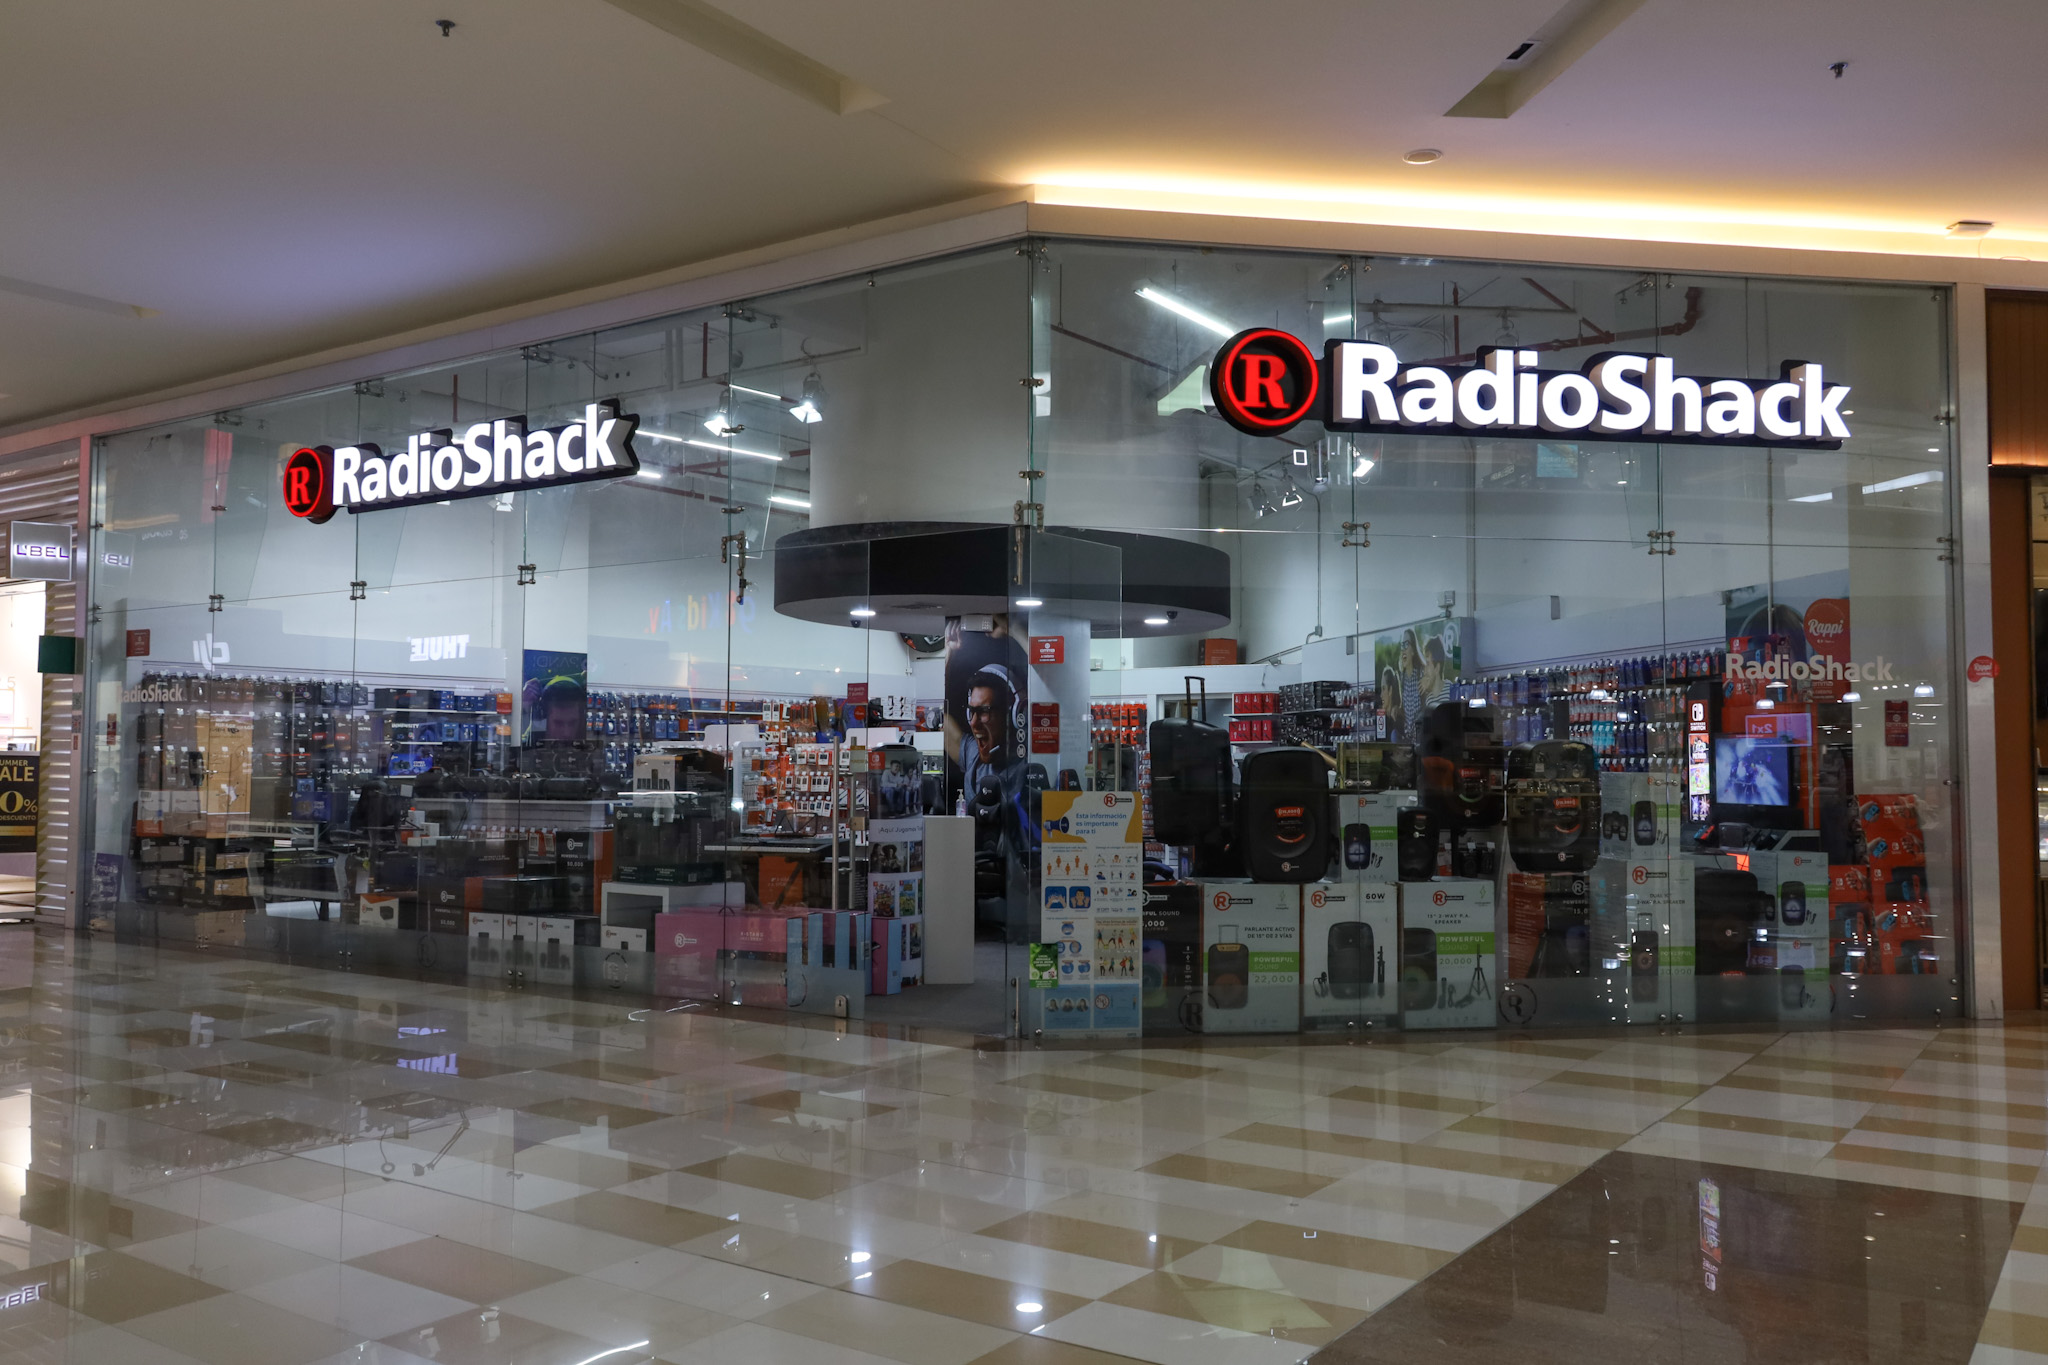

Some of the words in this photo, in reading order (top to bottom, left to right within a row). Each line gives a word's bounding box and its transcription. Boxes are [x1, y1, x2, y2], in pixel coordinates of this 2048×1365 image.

[1340, 343, 1851, 438] RadioShack
[332, 403, 616, 506] RadioShack
[16, 543, 70, 559] L'BEL
[1807, 618, 1844, 638] Rappi
[1725, 653, 1894, 681] RadioShack
[117, 684, 183, 702] RadioShack
[0, 767, 35, 782] ALE
[0, 790, 38, 814] 0%
[1439, 957, 1473, 965] 20,000
[1254, 975, 1294, 984] 22,000
